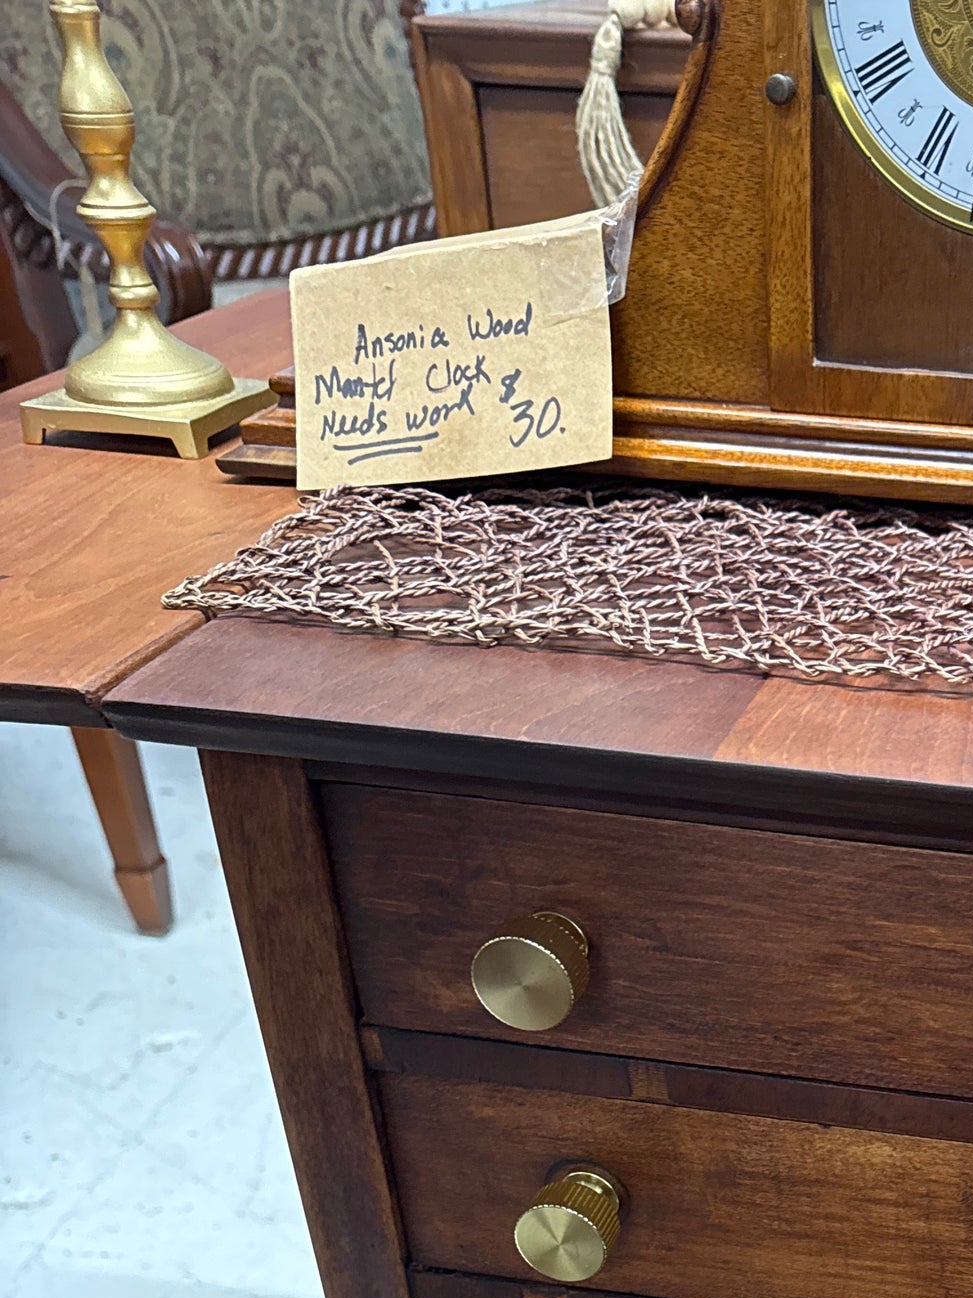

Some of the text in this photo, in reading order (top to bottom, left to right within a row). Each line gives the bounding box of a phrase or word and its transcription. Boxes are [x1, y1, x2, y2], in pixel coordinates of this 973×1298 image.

[354, 301, 532, 364] Ansonia Wood
[426, 355, 491, 393] Clock
[320, 402, 388, 440] Needs
